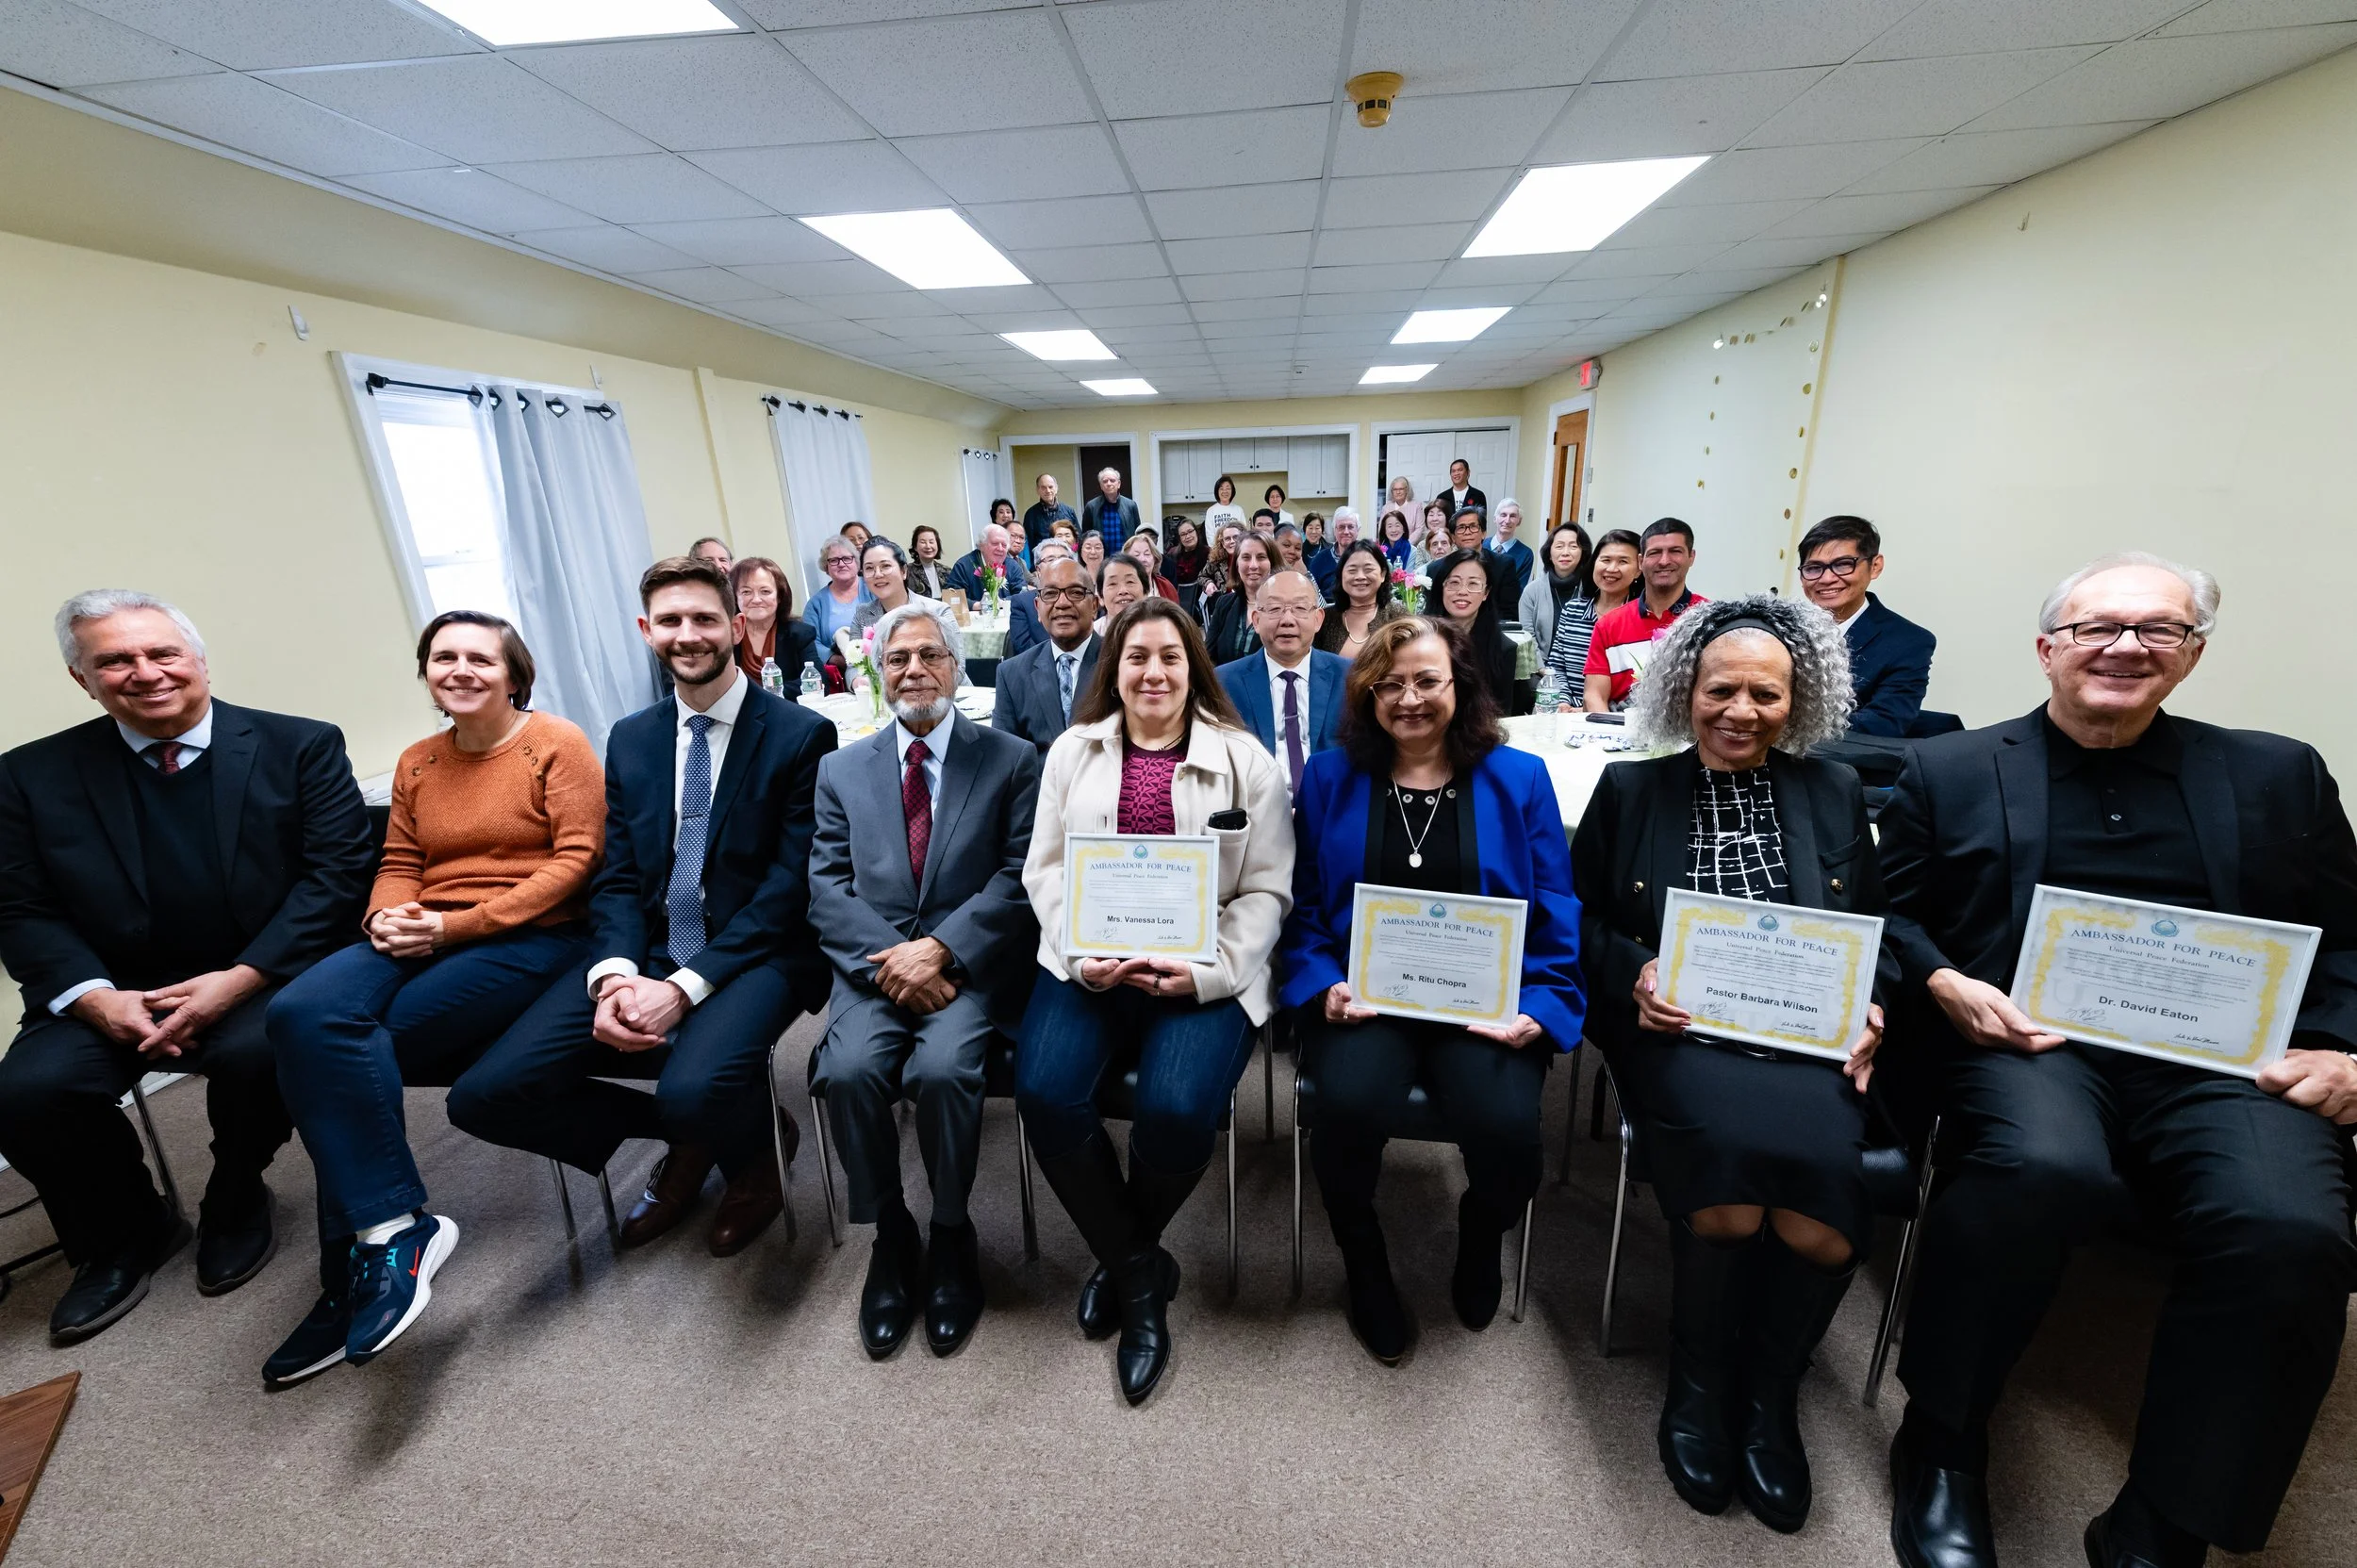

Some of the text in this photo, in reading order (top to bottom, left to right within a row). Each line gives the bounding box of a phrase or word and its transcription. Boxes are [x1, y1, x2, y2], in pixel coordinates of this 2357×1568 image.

[1166, 864, 1192, 872] PEACE
[1381, 918, 1494, 938] AMBASSADOR FOR PEACE
[1696, 927, 1838, 956] AMBASSADOR FOR PEACE
[1727, 942, 1753, 951] Universal
[1774, 949, 1804, 959] Federation
[2070, 929, 2256, 968] AMBASSADOR FOR PEACE
[2109, 946, 2210, 969] Universal Peace Federation
[1418, 975, 1435, 984] Ritu
[1437, 978, 1467, 988] Chopra
[1706, 987, 1818, 1013] Pastor Barbara Wilson
[2098, 996, 2199, 1023] Dr. David Eaton
